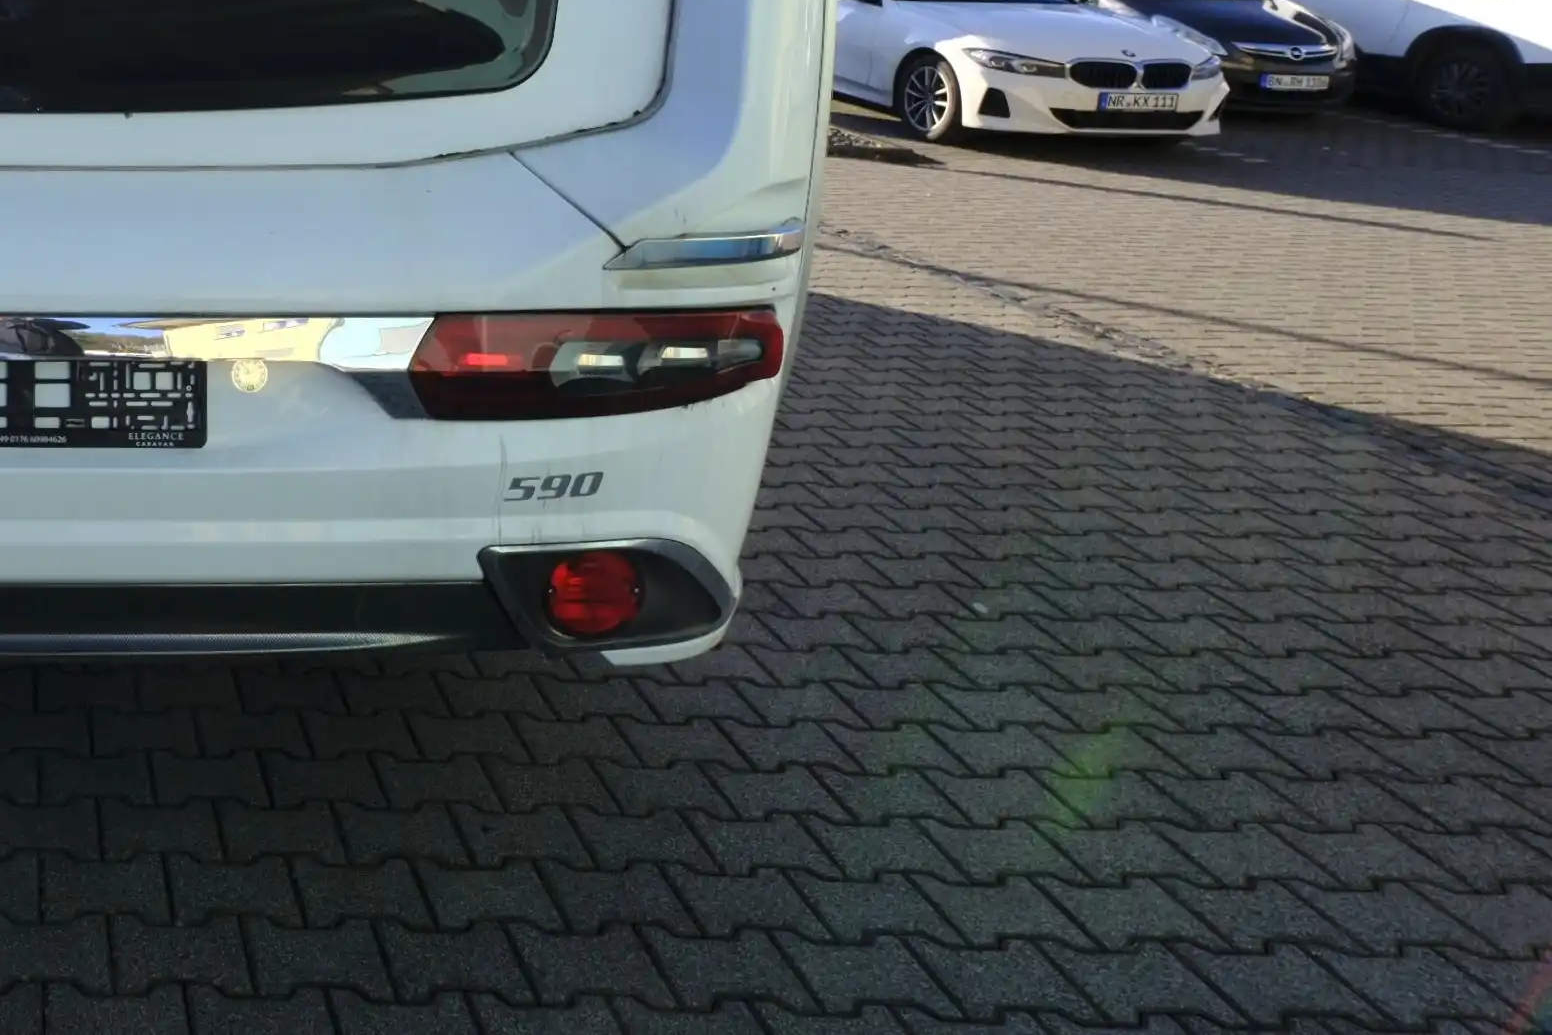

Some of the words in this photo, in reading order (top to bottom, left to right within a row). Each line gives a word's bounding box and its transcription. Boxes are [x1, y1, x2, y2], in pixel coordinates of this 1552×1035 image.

[1108, 95, 1125, 107] NR
[1153, 96, 1174, 108] 111
[128, 432, 184, 440] ELEGANCE
[503, 471, 604, 502] 590
